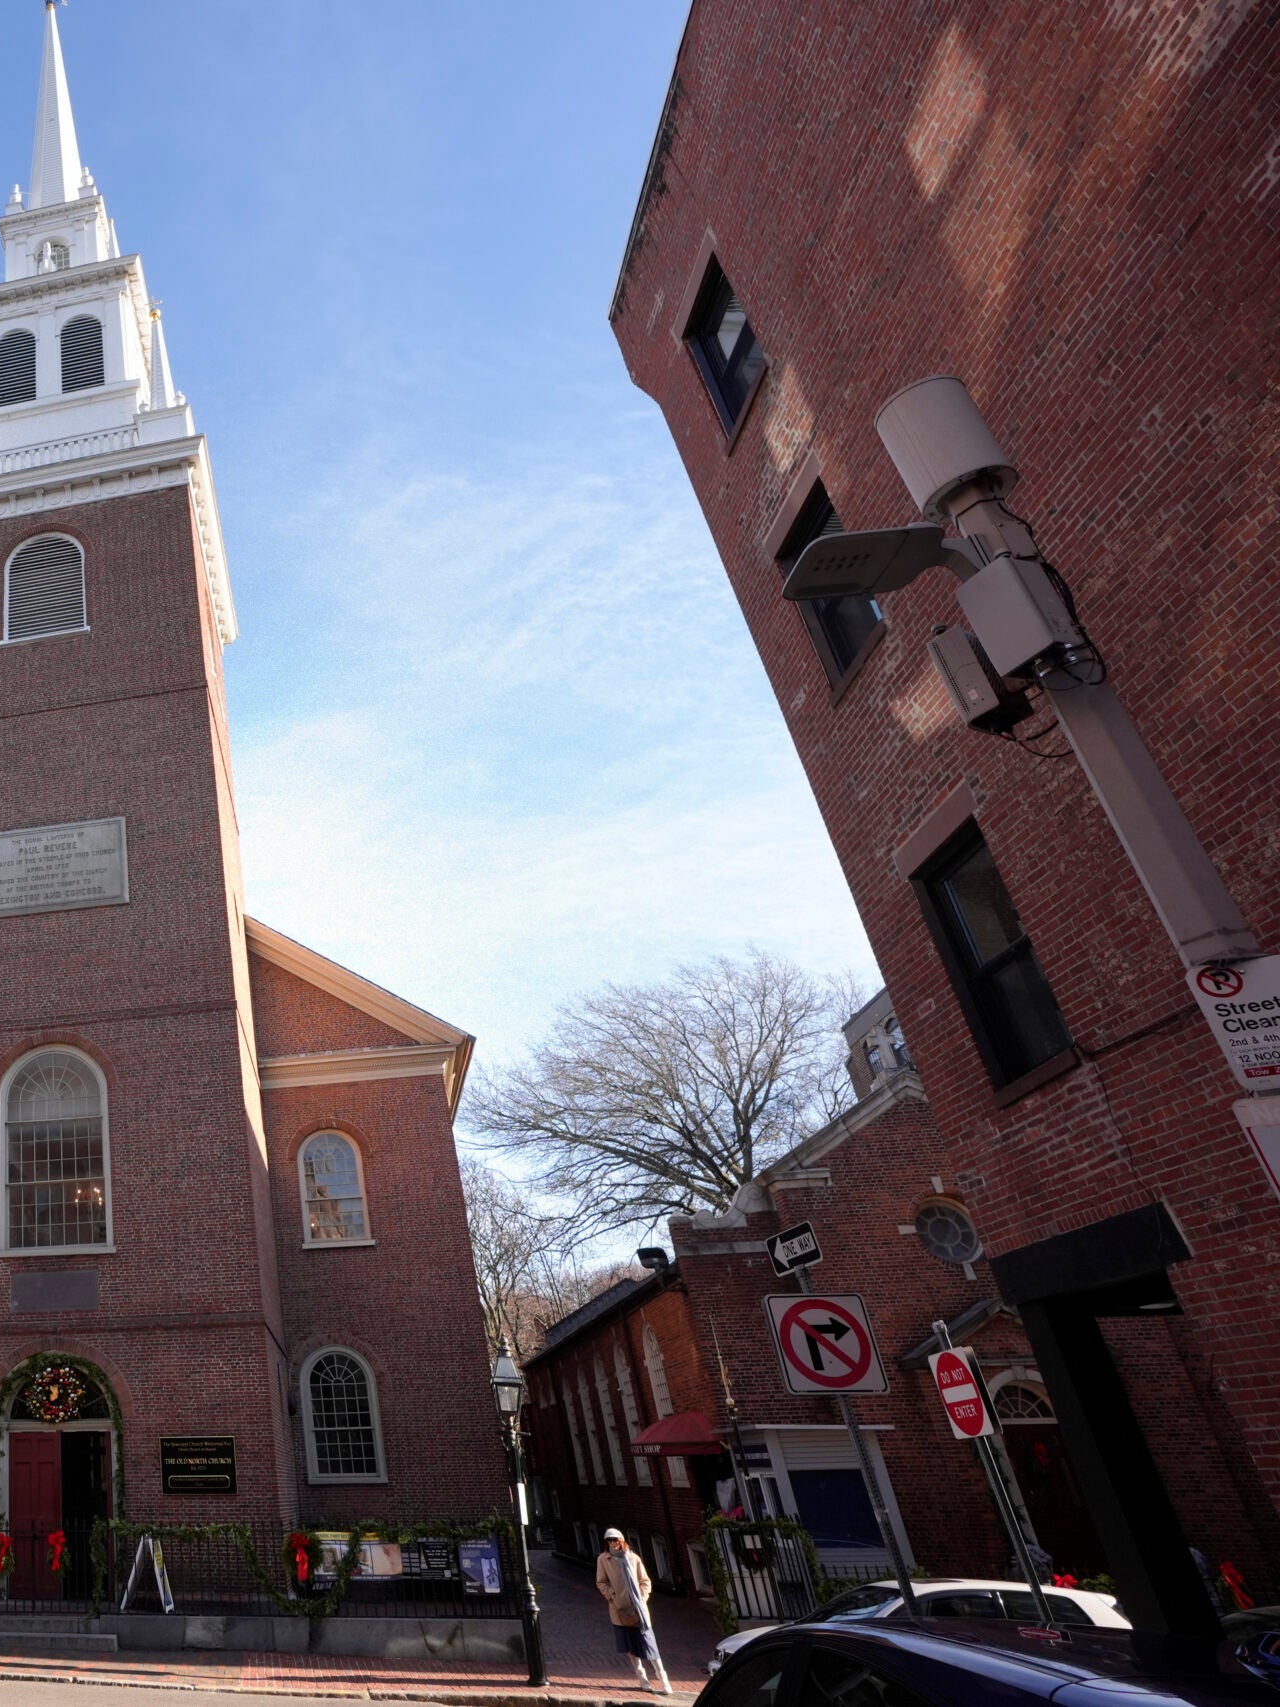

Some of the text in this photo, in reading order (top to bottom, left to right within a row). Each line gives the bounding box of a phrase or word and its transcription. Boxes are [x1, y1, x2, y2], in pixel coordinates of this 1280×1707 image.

[18, 841, 78, 855] PAUL REVERE
[92, 848, 117, 856] CHURCH
[17, 876, 29, 884] THE
[31, 873, 59, 882] COUNTRY
[72, 870, 84, 878] THE
[44, 890, 61, 900] AND
[1229, 1037, 1249, 1047] 2nd
[1251, 1036, 1260, 1044] &
[1238, 1055, 1251, 1063] 12
[1249, 1068, 1270, 1077] Tow
[782, 1234, 813, 1258] ONE WAY
[940, 1367, 965, 1384] DO NOT
[954, 1403, 977, 1419] ENTER
[643, 1444, 661, 1454] SHOP
[188, 1457, 208, 1465] NORTH
[208, 1457, 232, 1465] CHURCH
